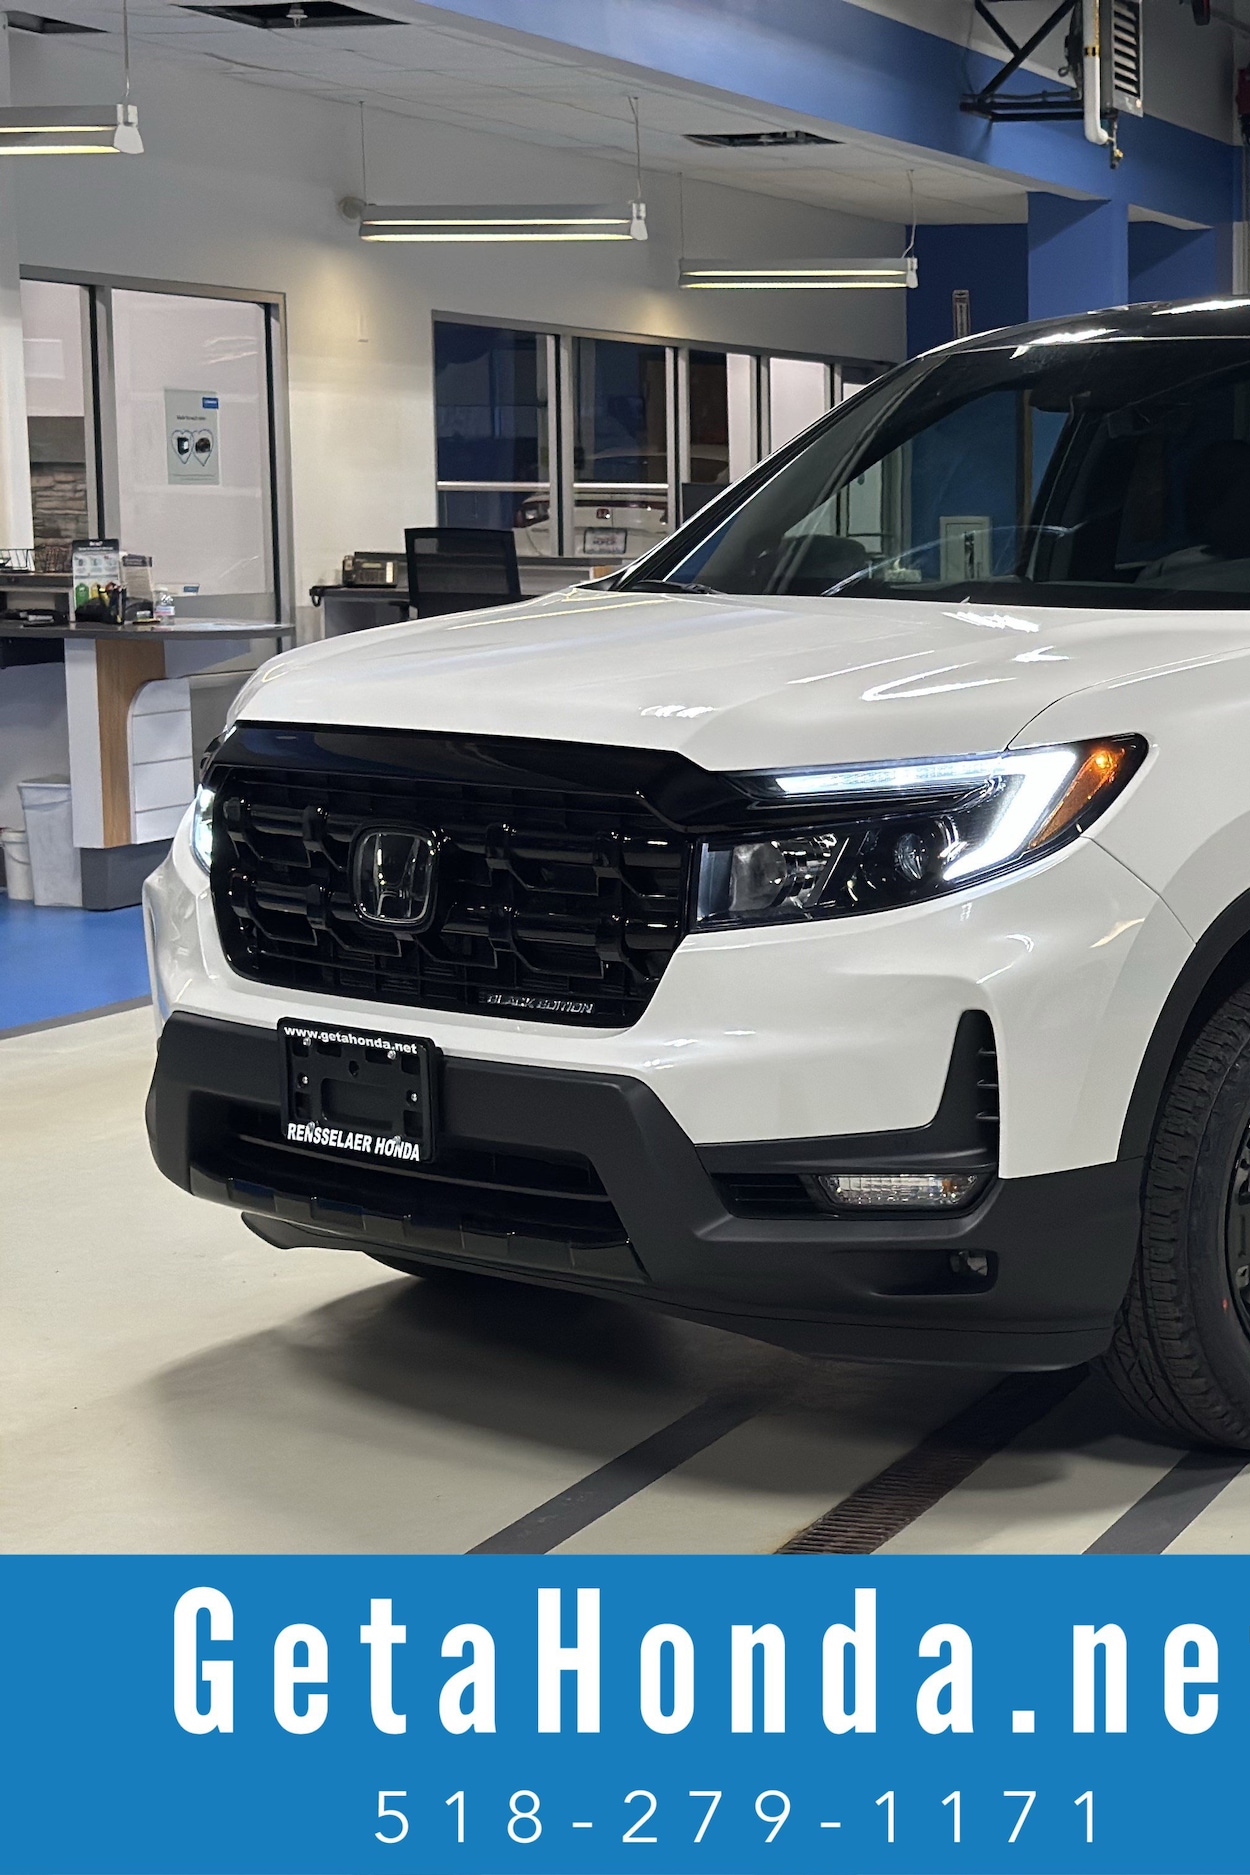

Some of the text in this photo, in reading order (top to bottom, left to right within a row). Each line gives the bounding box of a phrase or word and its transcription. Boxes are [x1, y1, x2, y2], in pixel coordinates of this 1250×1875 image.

[536, 999, 594, 1014] EDITION
[284, 1026, 418, 1054] www.getahonda.net
[287, 1123, 420, 1161] RENSSELAER HONDA
